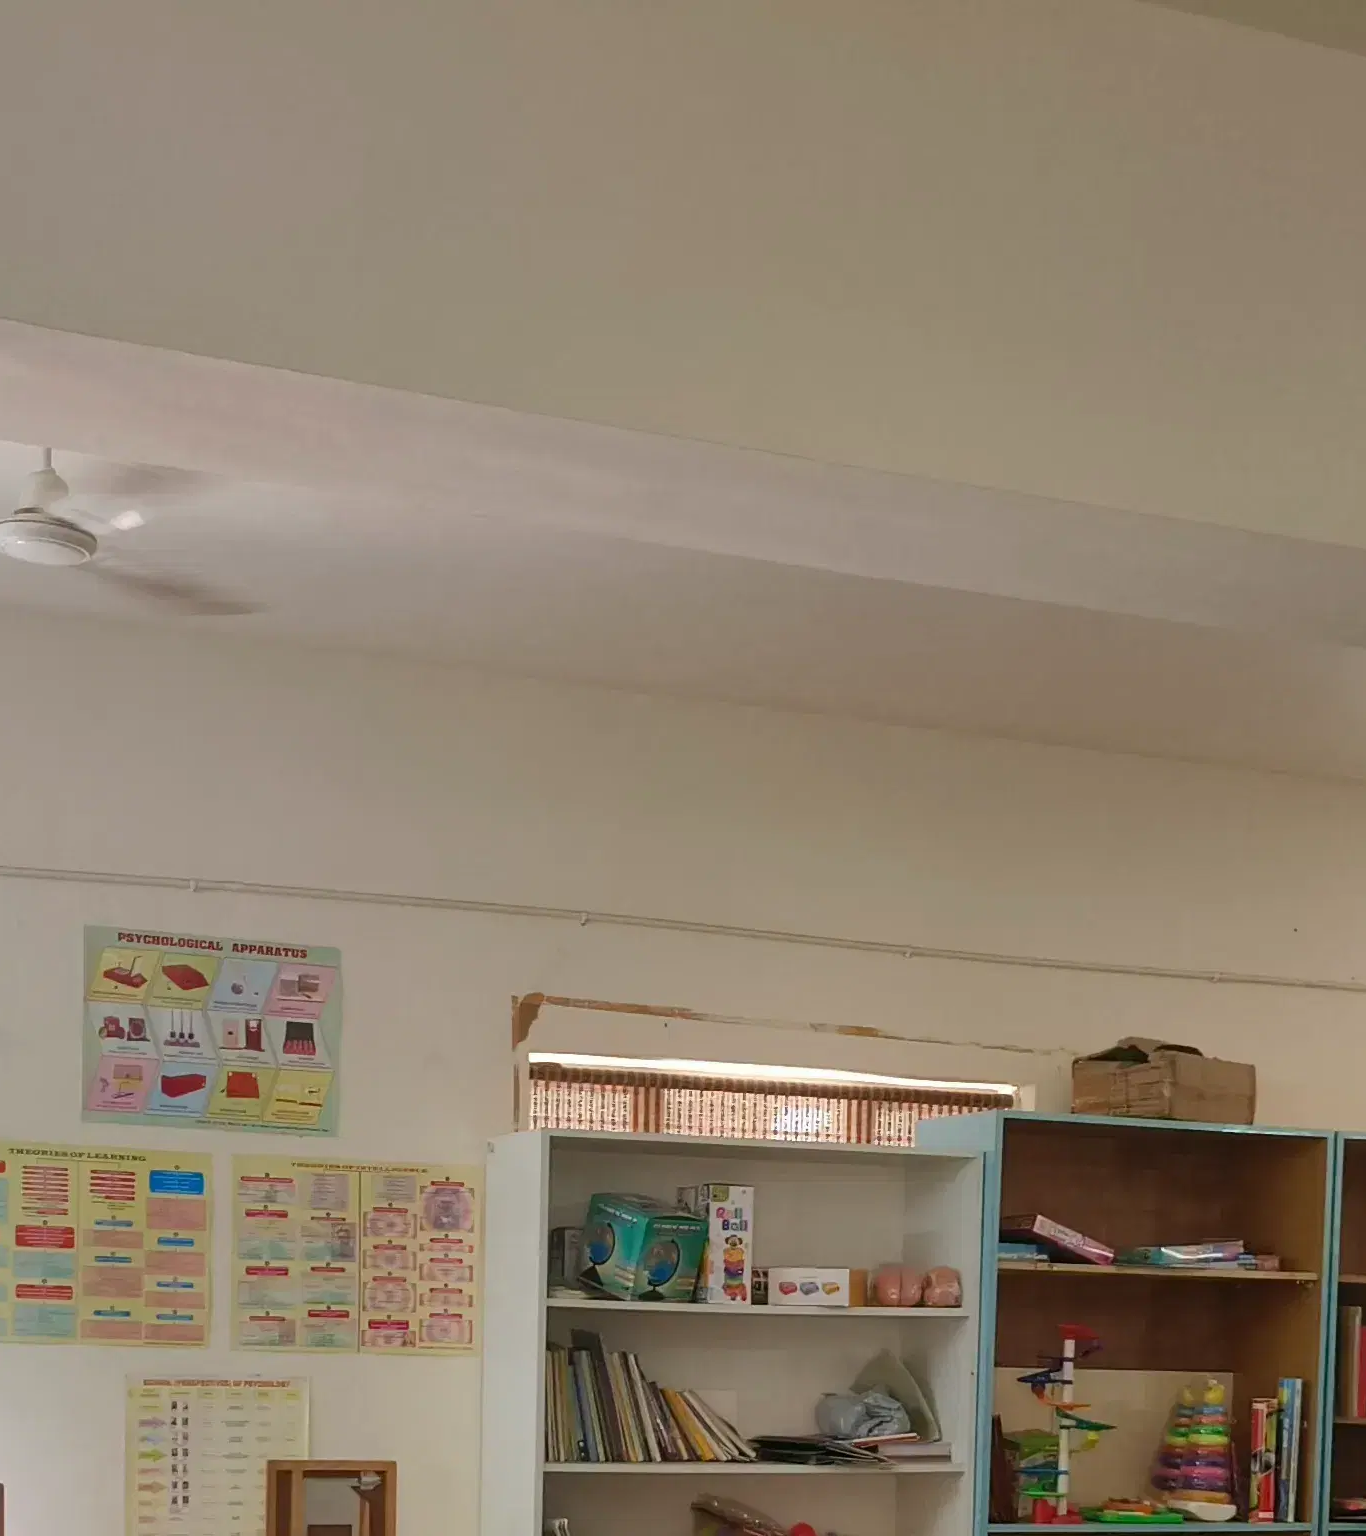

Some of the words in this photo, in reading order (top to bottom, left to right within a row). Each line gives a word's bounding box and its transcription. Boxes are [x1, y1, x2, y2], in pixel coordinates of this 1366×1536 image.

[117, 931, 224, 951] PSYCHOLOGICAL
[231, 942, 308, 959] APPARATUS
[8, 1147, 68, 1158] THEORIES
[86, 1152, 147, 1162] LEARNING
